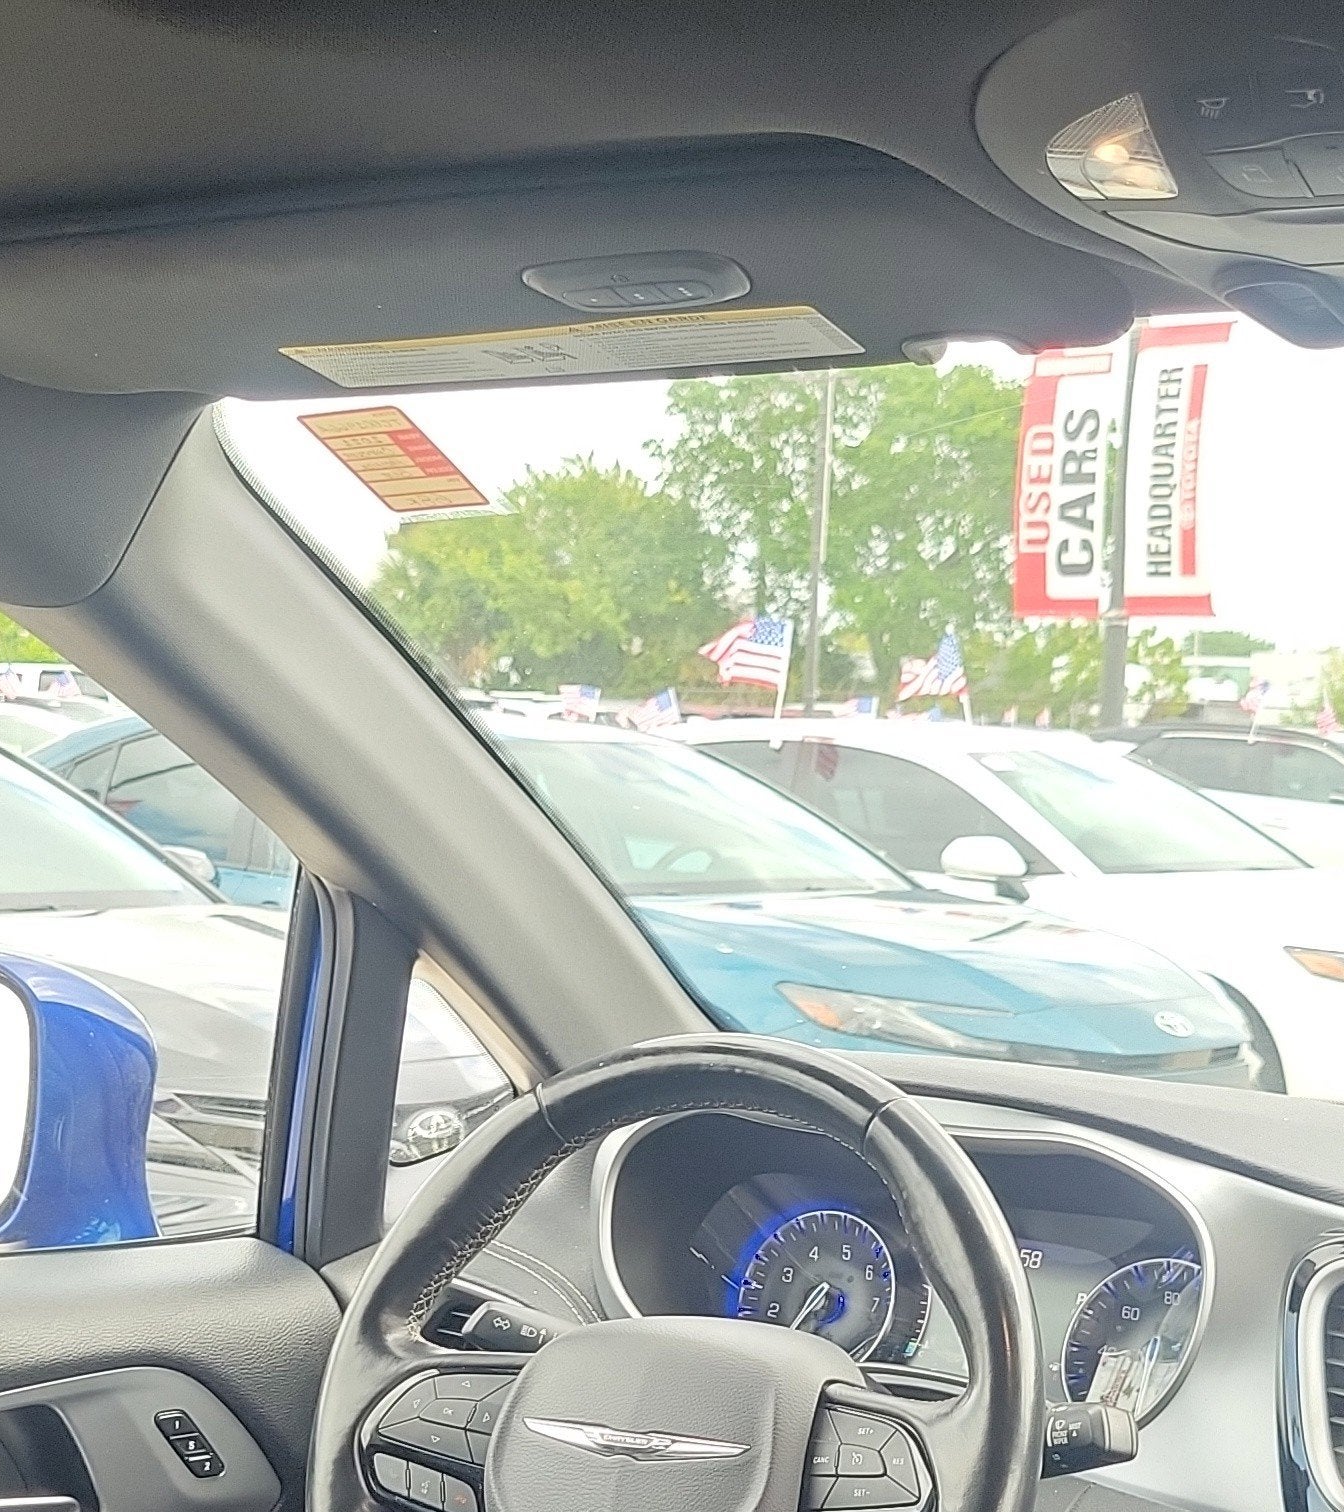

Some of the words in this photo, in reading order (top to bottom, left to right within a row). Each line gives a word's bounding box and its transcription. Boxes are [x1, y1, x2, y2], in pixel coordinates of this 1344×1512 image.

[1146, 366, 1184, 578] HEADQUARTER
[1023, 430, 1054, 546] USED
[1057, 408, 1101, 577] CARS
[808, 1246, 819, 1262] 4
[841, 1244, 851, 1260] 5
[1019, 1248, 1043, 1269] 58
[781, 1267, 794, 1283] 3
[865, 1265, 874, 1281] 6
[871, 1297, 881, 1312] 7
[1164, 1291, 1181, 1306] 80
[767, 1302, 780, 1318] 2
[1122, 1306, 1140, 1321] 60
[175, 1420, 180, 1429] 1
[204, 1461, 211, 1471] 2
